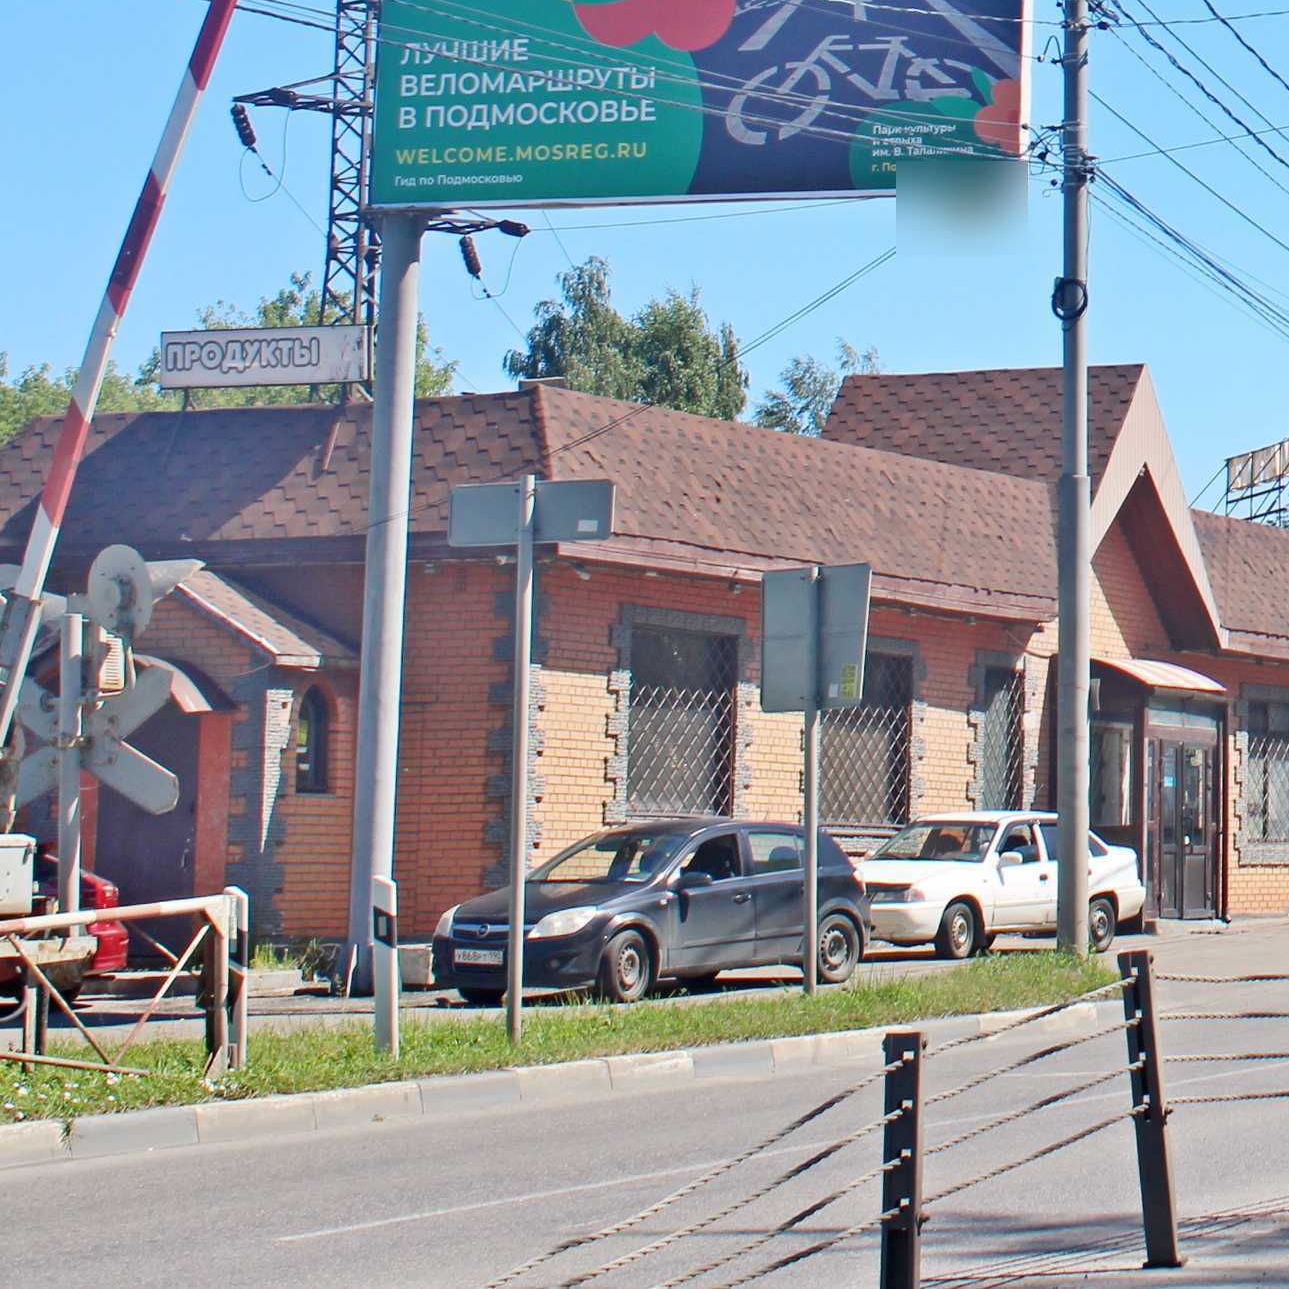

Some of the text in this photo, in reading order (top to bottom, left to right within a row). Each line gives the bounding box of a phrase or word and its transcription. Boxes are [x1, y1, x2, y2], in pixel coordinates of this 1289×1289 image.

[400, 38, 530, 66] ЛУЧШИЕ
[400, 67, 656, 97] ВЕЛОМАРШРУТЫ
[399, 99, 657, 131] В ПОДМОСКОВЬЕ
[396, 142, 647, 165] WELCOME.MOSREG.RU
[394, 173, 523, 187] Гид по Подмосковью
[165, 336, 321, 374] ПРОДУКТЫ
